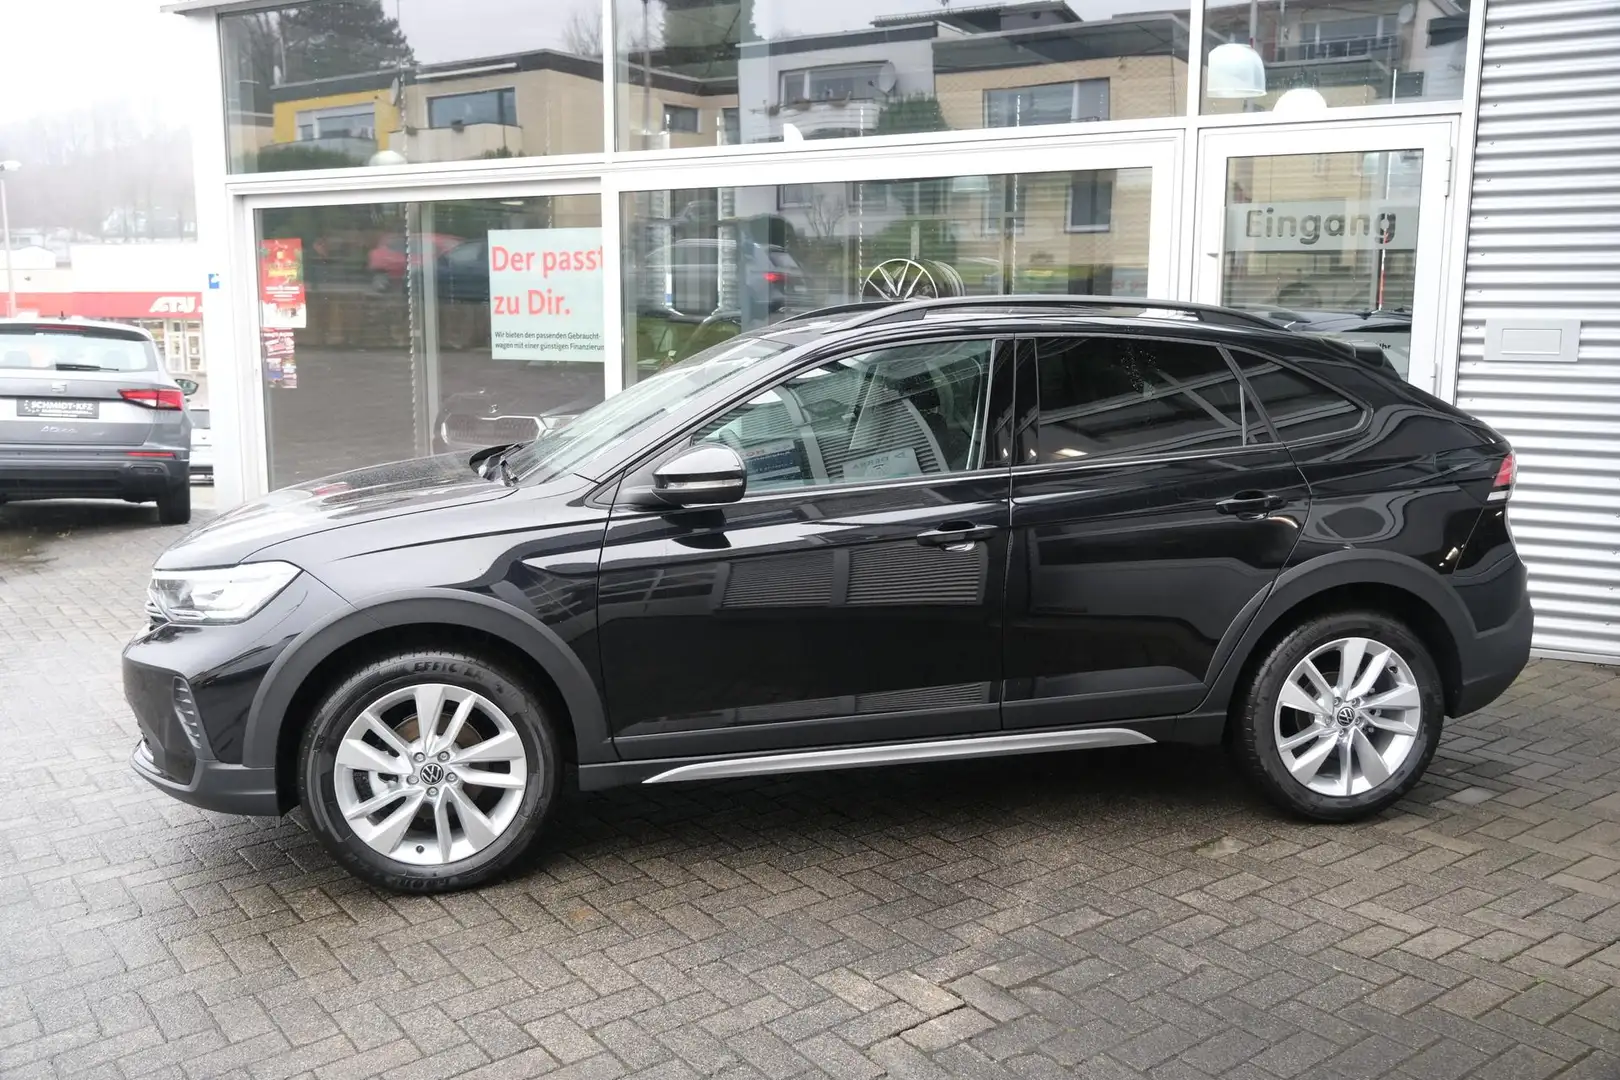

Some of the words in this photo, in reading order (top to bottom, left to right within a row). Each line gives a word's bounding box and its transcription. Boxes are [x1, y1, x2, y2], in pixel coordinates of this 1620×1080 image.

[1246, 207, 1396, 245] Eingang
[492, 246, 536, 271] Der
[493, 295, 520, 315] zu
[527, 288, 571, 315] Dir.
[536, 332, 567, 340] passenden
